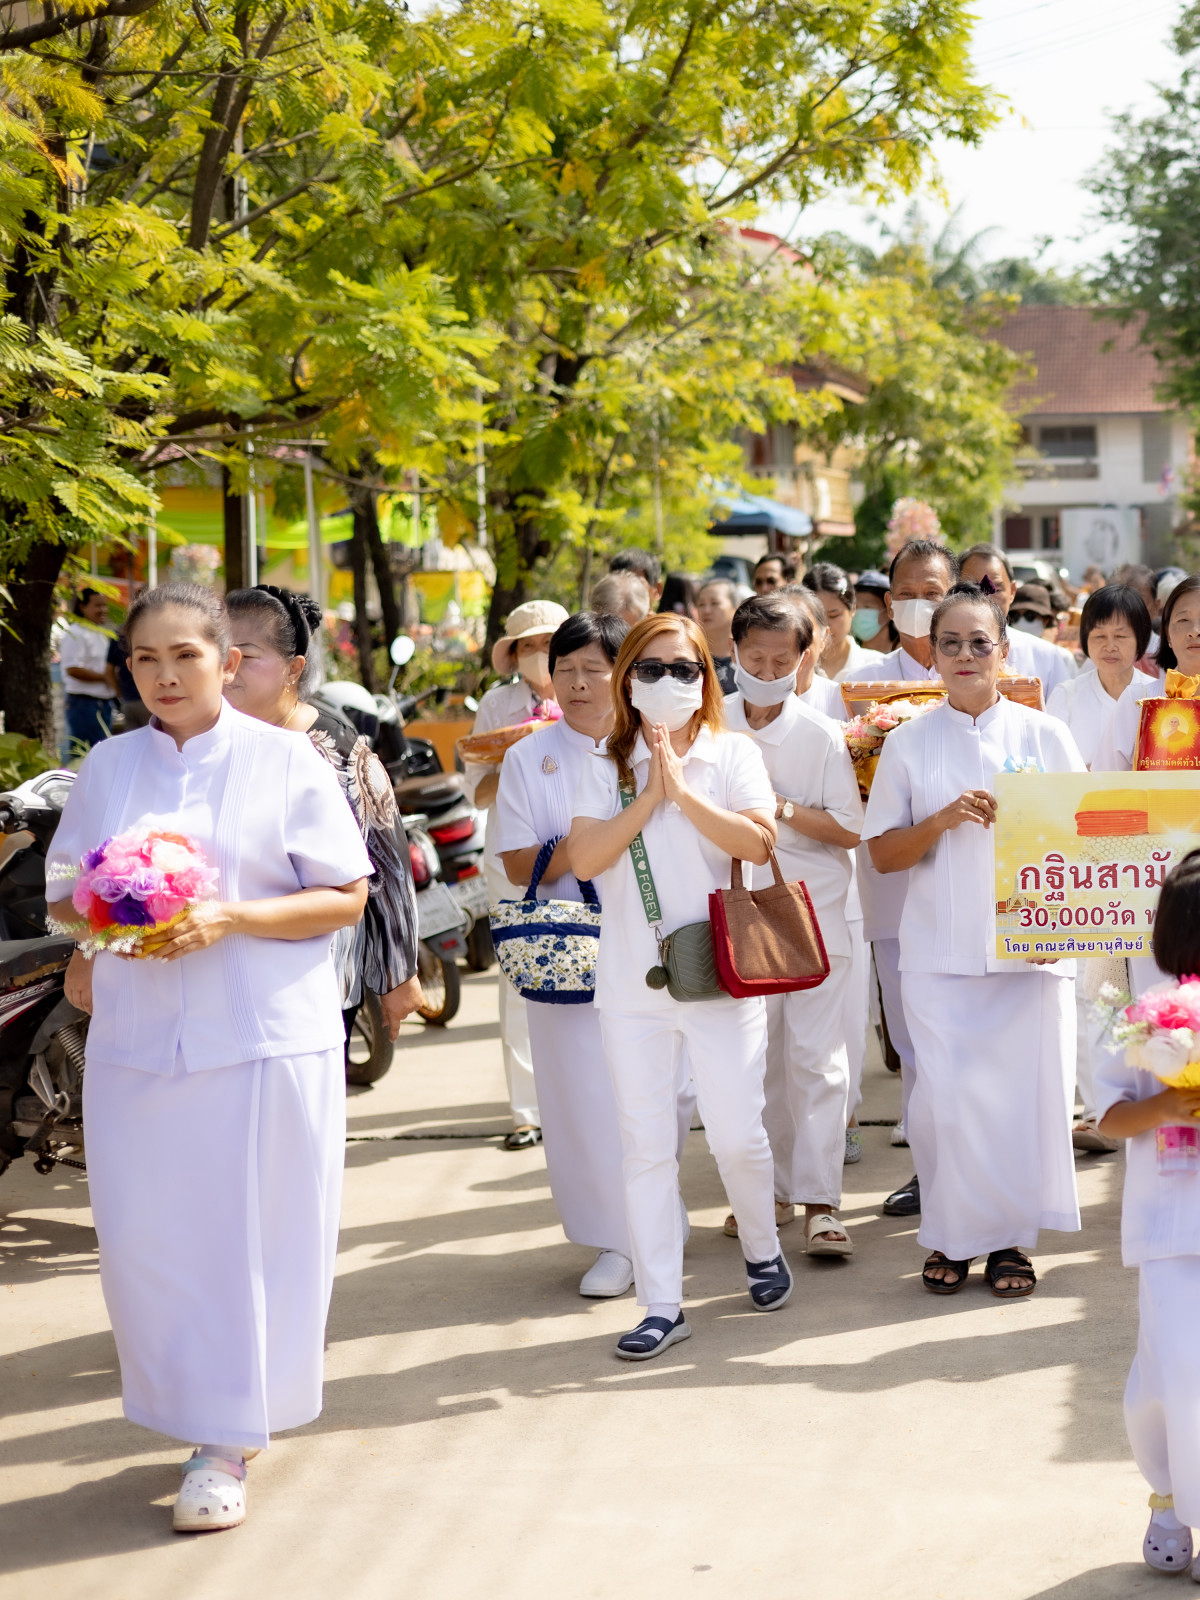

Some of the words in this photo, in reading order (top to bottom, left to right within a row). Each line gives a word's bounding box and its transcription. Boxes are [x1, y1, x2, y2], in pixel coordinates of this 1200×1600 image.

[1019, 901, 1136, 931] 30,000วัด
[1005, 938, 1030, 953] โดย
[1035, 935, 1143, 955] คณะศิษยานุศิษย์
